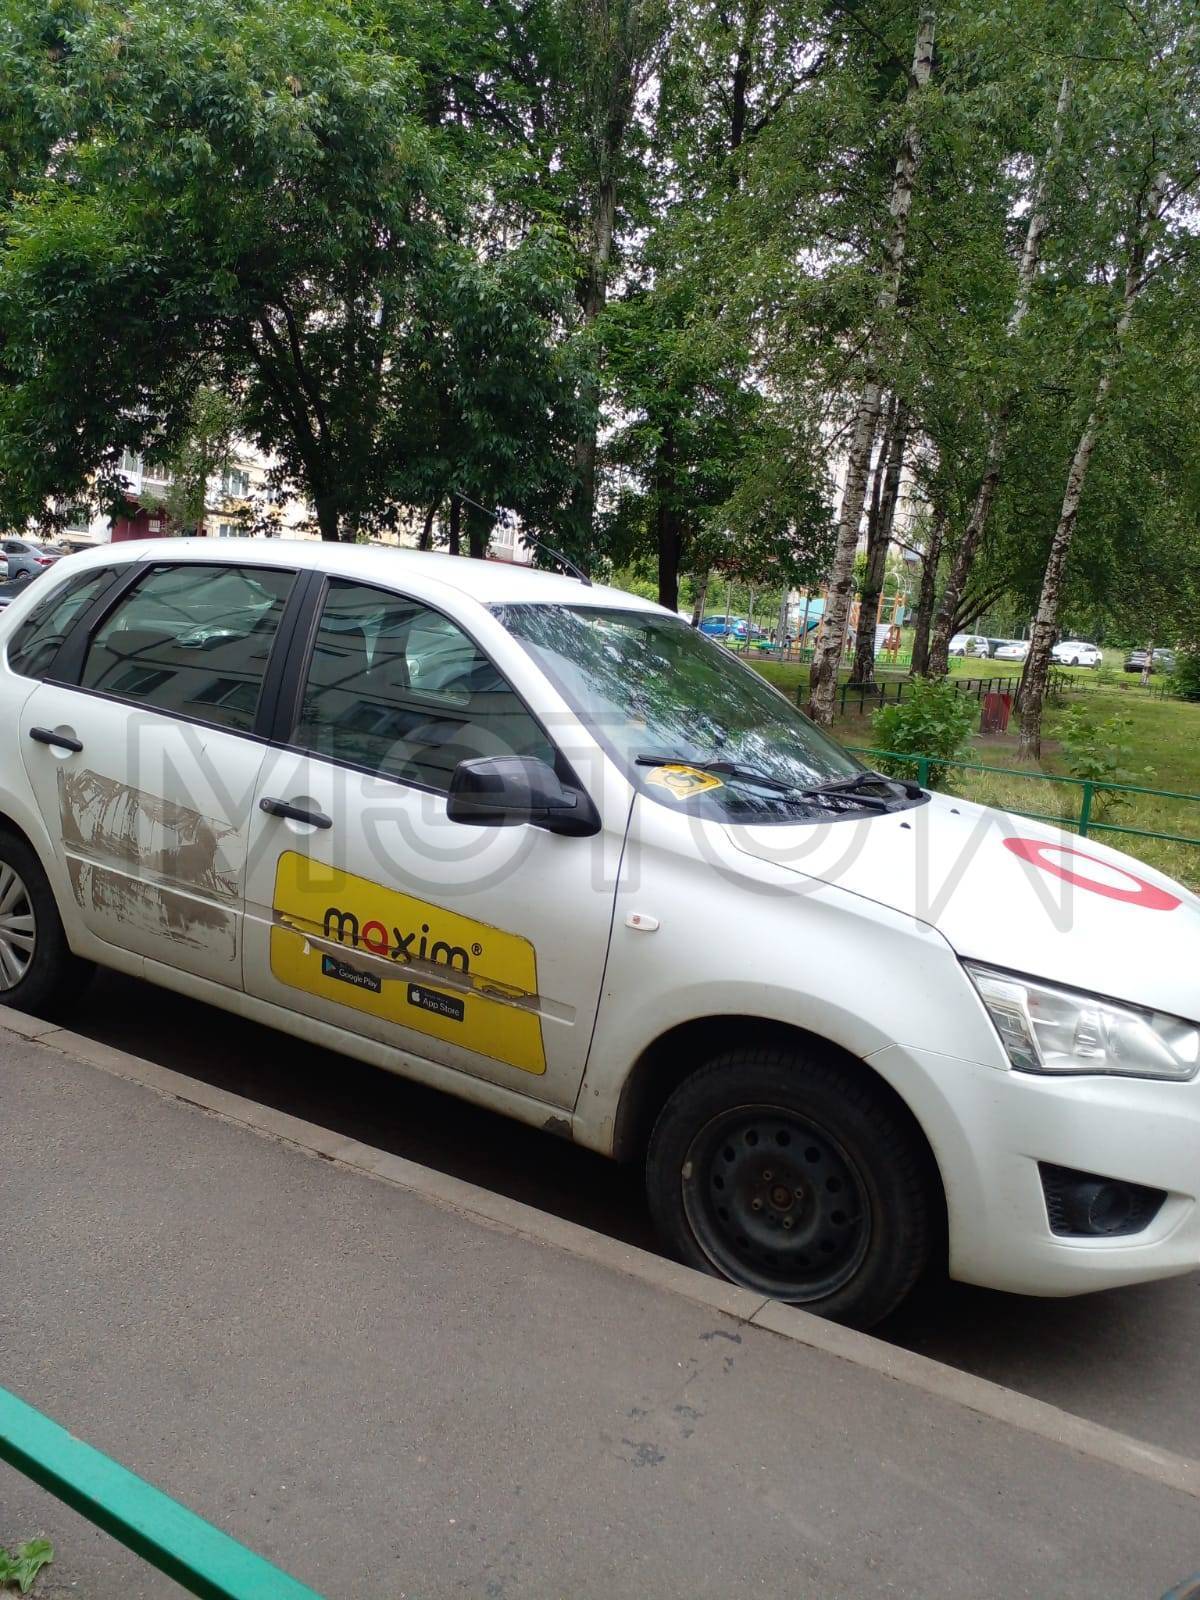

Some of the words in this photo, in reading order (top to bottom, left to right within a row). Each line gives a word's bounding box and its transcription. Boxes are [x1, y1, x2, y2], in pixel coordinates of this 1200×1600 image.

[338, 967, 363, 984] Google
[363, 976, 378, 990] Play
[422, 997, 439, 1009] App
[440, 1002, 460, 1017] Store
